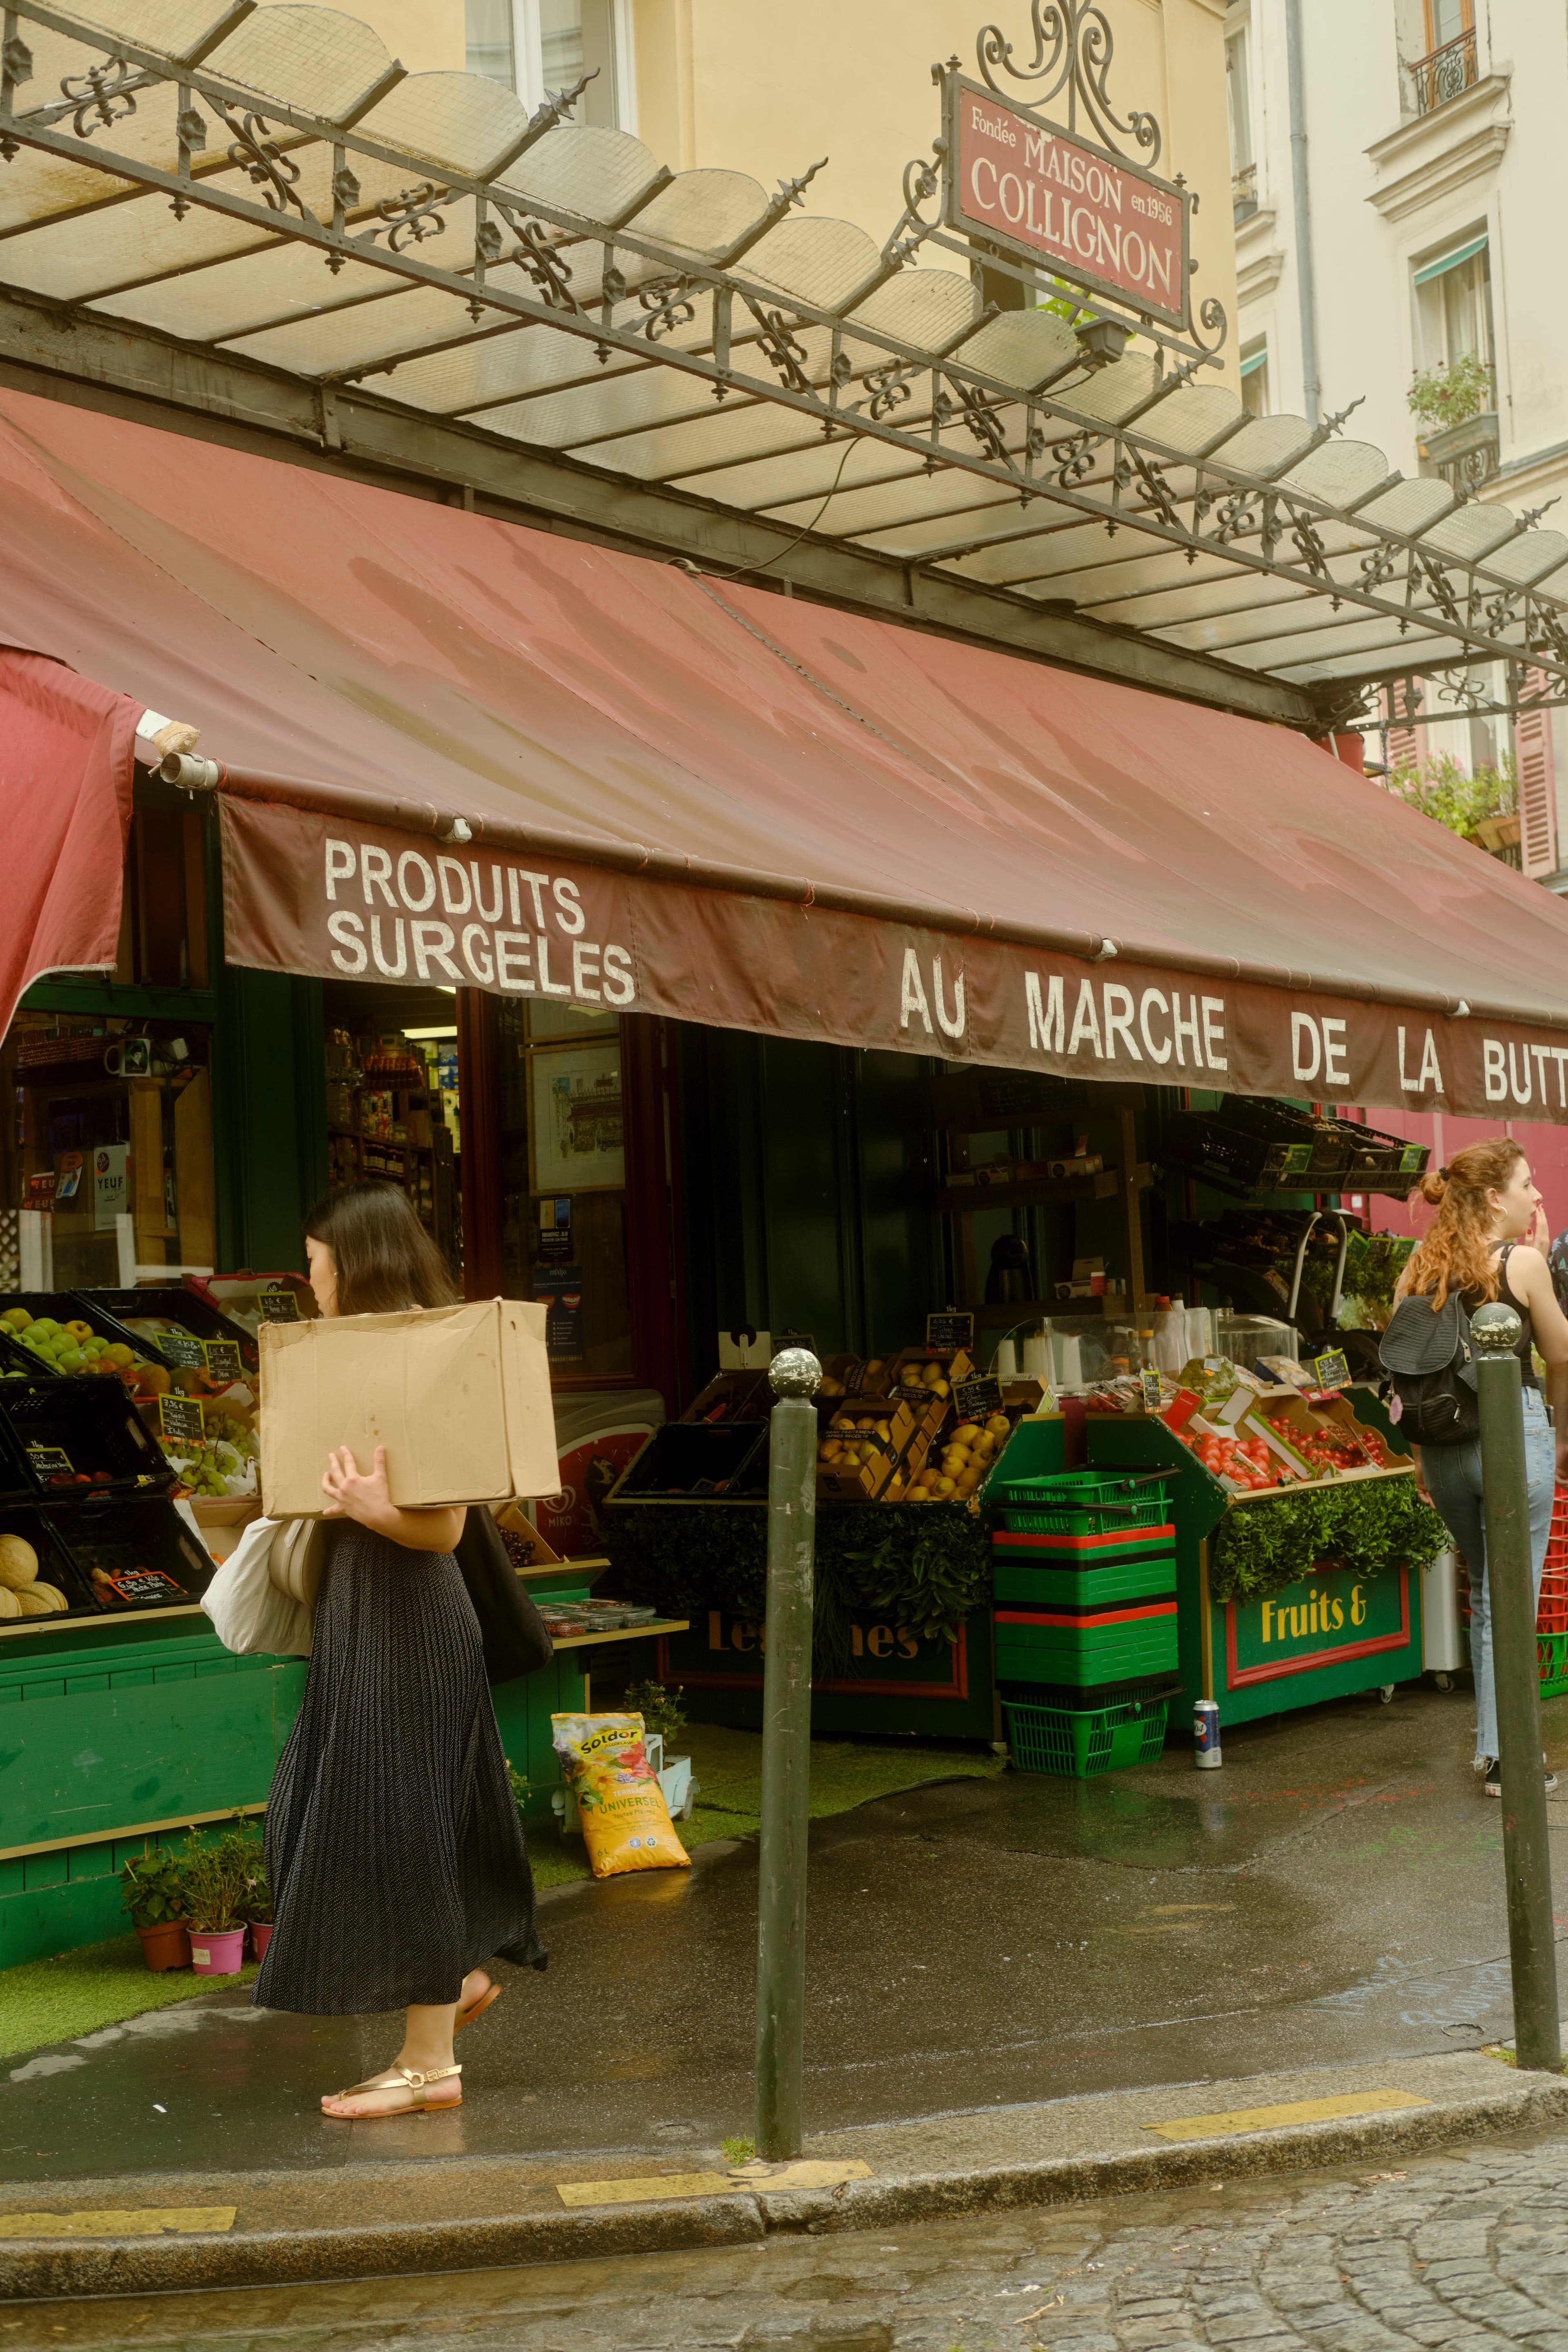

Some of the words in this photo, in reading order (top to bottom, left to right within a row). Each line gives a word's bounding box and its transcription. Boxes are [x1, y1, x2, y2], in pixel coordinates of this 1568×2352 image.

[972, 106, 1016, 147] Fondée
[1024, 133, 1122, 214] MAISON
[1131, 195, 1146, 215] en
[1147, 199, 1172, 226] 1956
[971, 157, 1172, 296] COLLIGNON
[325, 838, 585, 934] PRODUITS
[327, 911, 635, 1004] SURGELES
[900, 948, 965, 1038] AU
[1025, 971, 1227, 1071] MARCHE
[1291, 1011, 1350, 1085] DE
[1398, 1026, 1445, 1093] LA
[1483, 1039, 1568, 1107] BUTT
[98, 1177, 122, 1189] YEUF
[946, 1305, 956, 1313] 1kg
[174, 1386, 185, 1397] 1kg
[548, 1515, 572, 1528] MIKO
[1262, 1589, 1344, 1643] Fruits
[1351, 1585, 1366, 1626] &
[581, 1731, 637, 1754] Soldor
[599, 1797, 661, 1814] UNIVERSEL
[613, 1788, 646, 1797] TERREAU
